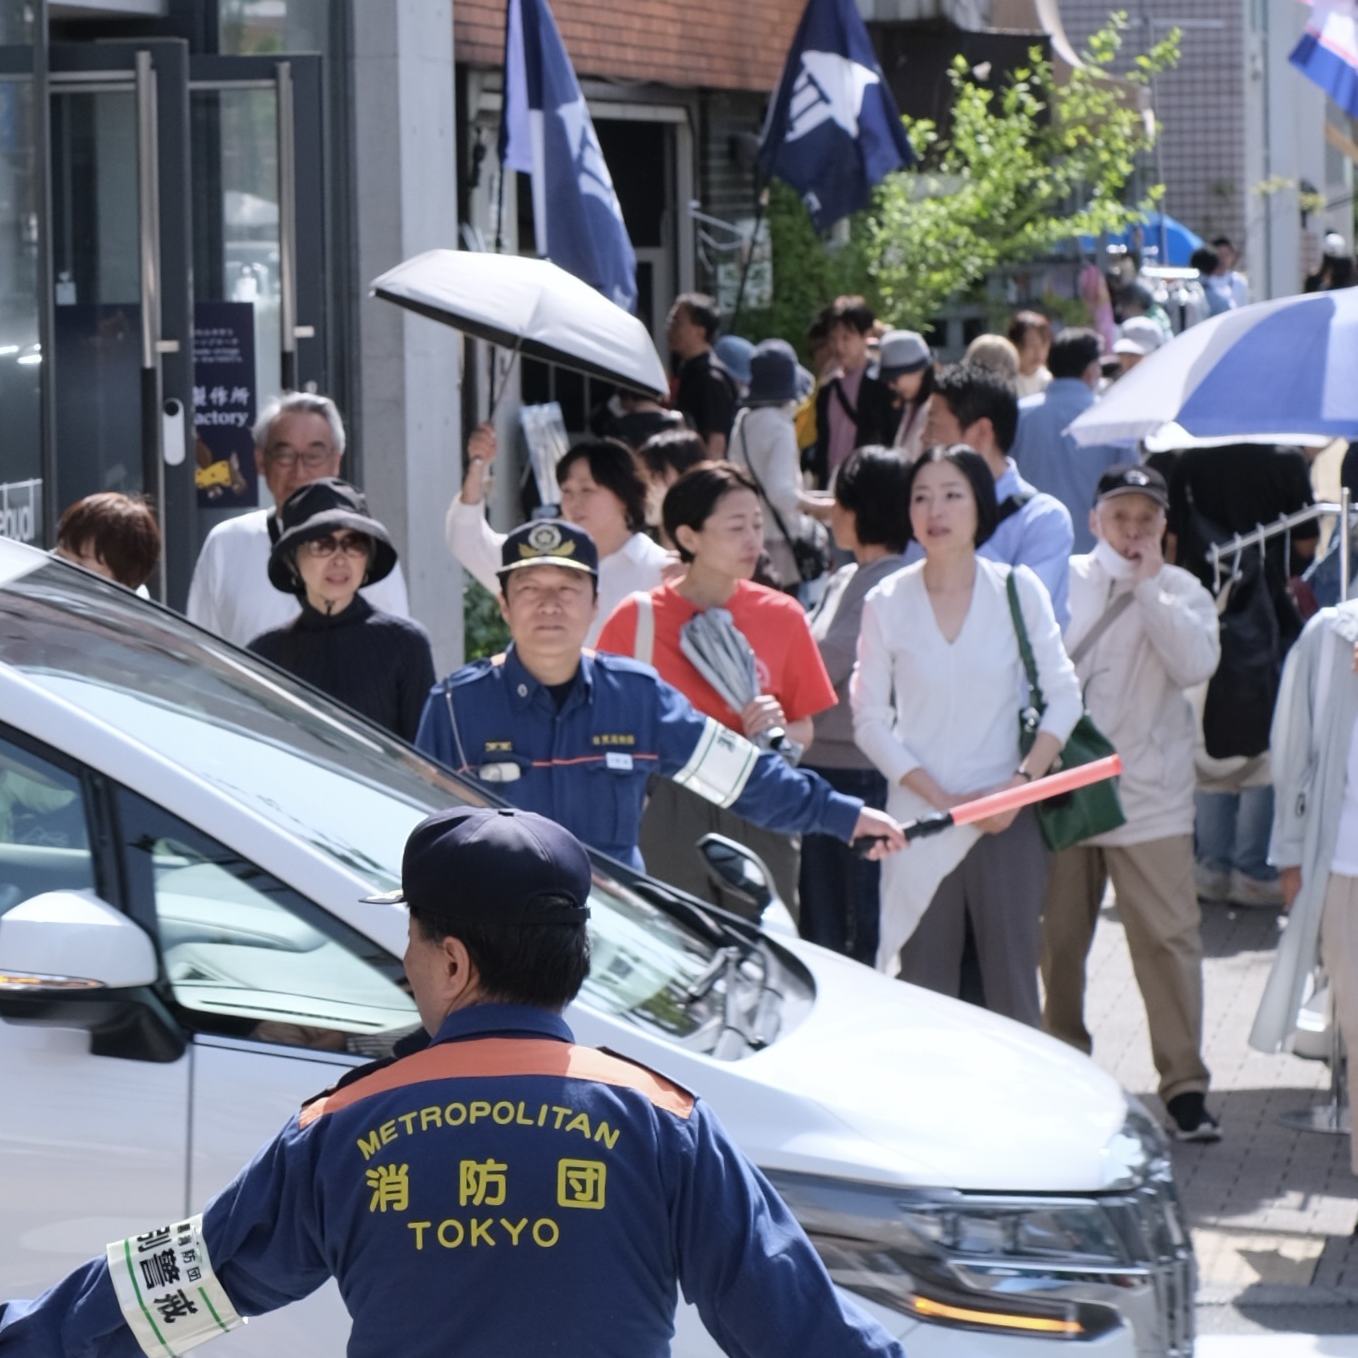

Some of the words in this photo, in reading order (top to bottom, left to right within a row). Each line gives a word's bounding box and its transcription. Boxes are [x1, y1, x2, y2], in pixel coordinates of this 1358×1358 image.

[193, 412, 249, 428] actory
[357, 1101, 620, 1160] METROPOLITAN
[365, 1158, 607, 1213] 消防団
[408, 1217, 560, 1250] TOKYO
